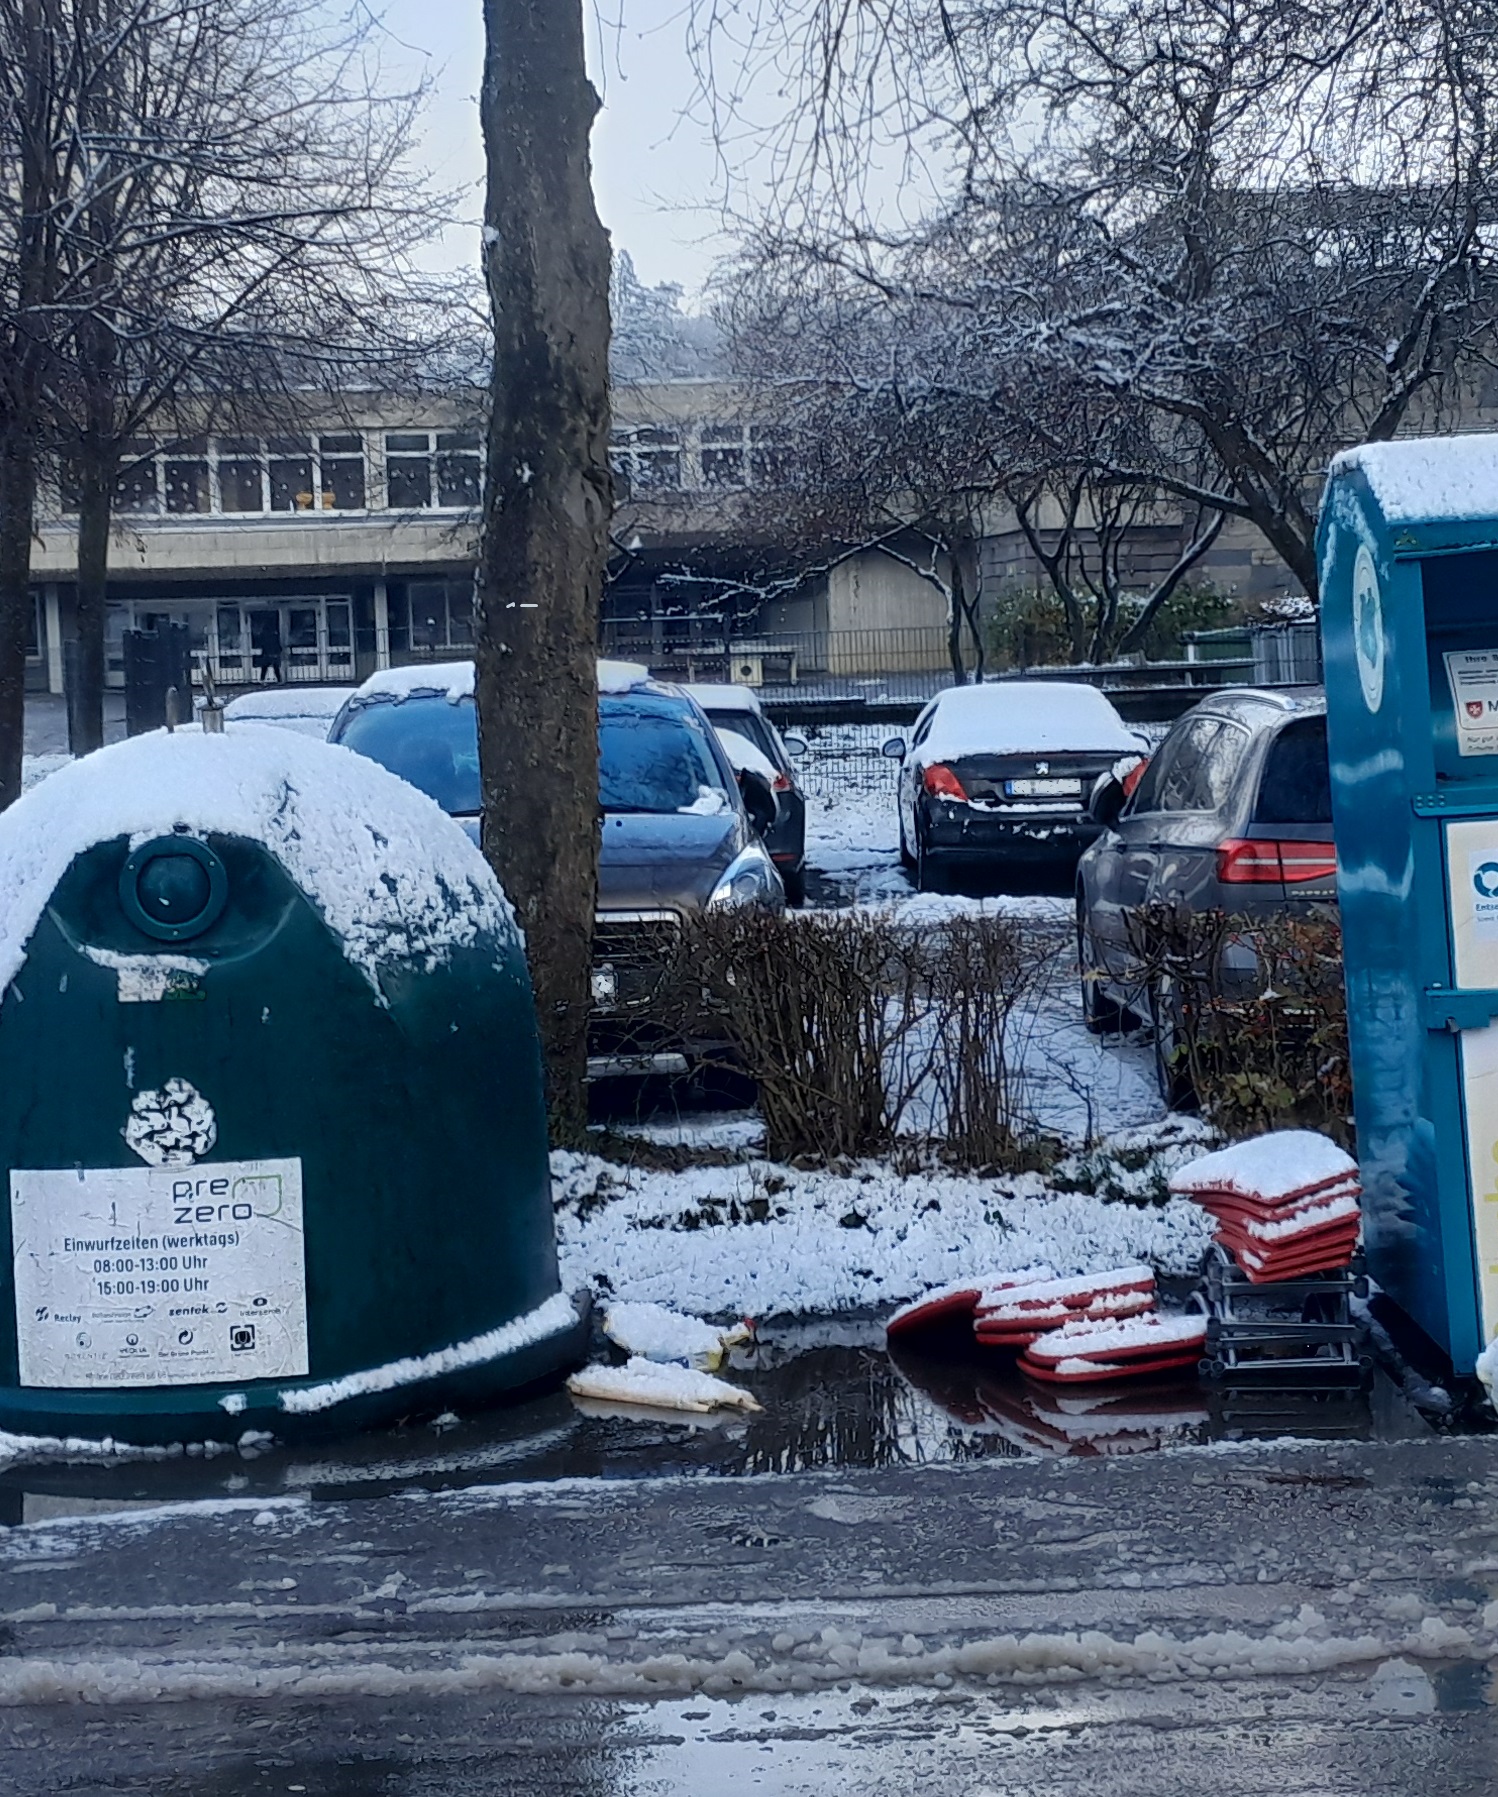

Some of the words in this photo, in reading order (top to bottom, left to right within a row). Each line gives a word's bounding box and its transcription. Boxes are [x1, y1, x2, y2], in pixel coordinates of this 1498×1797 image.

[173, 1178, 230, 1204] pre
[173, 1203, 253, 1225] zero
[64, 1235, 159, 1252] Einwurfzeiten
[162, 1230, 240, 1250] (werktags)
[93, 1256, 178, 1273] 08:00-13:00
[182, 1255, 208, 1270] Uhr
[183, 1277, 209, 1292] Uhr
